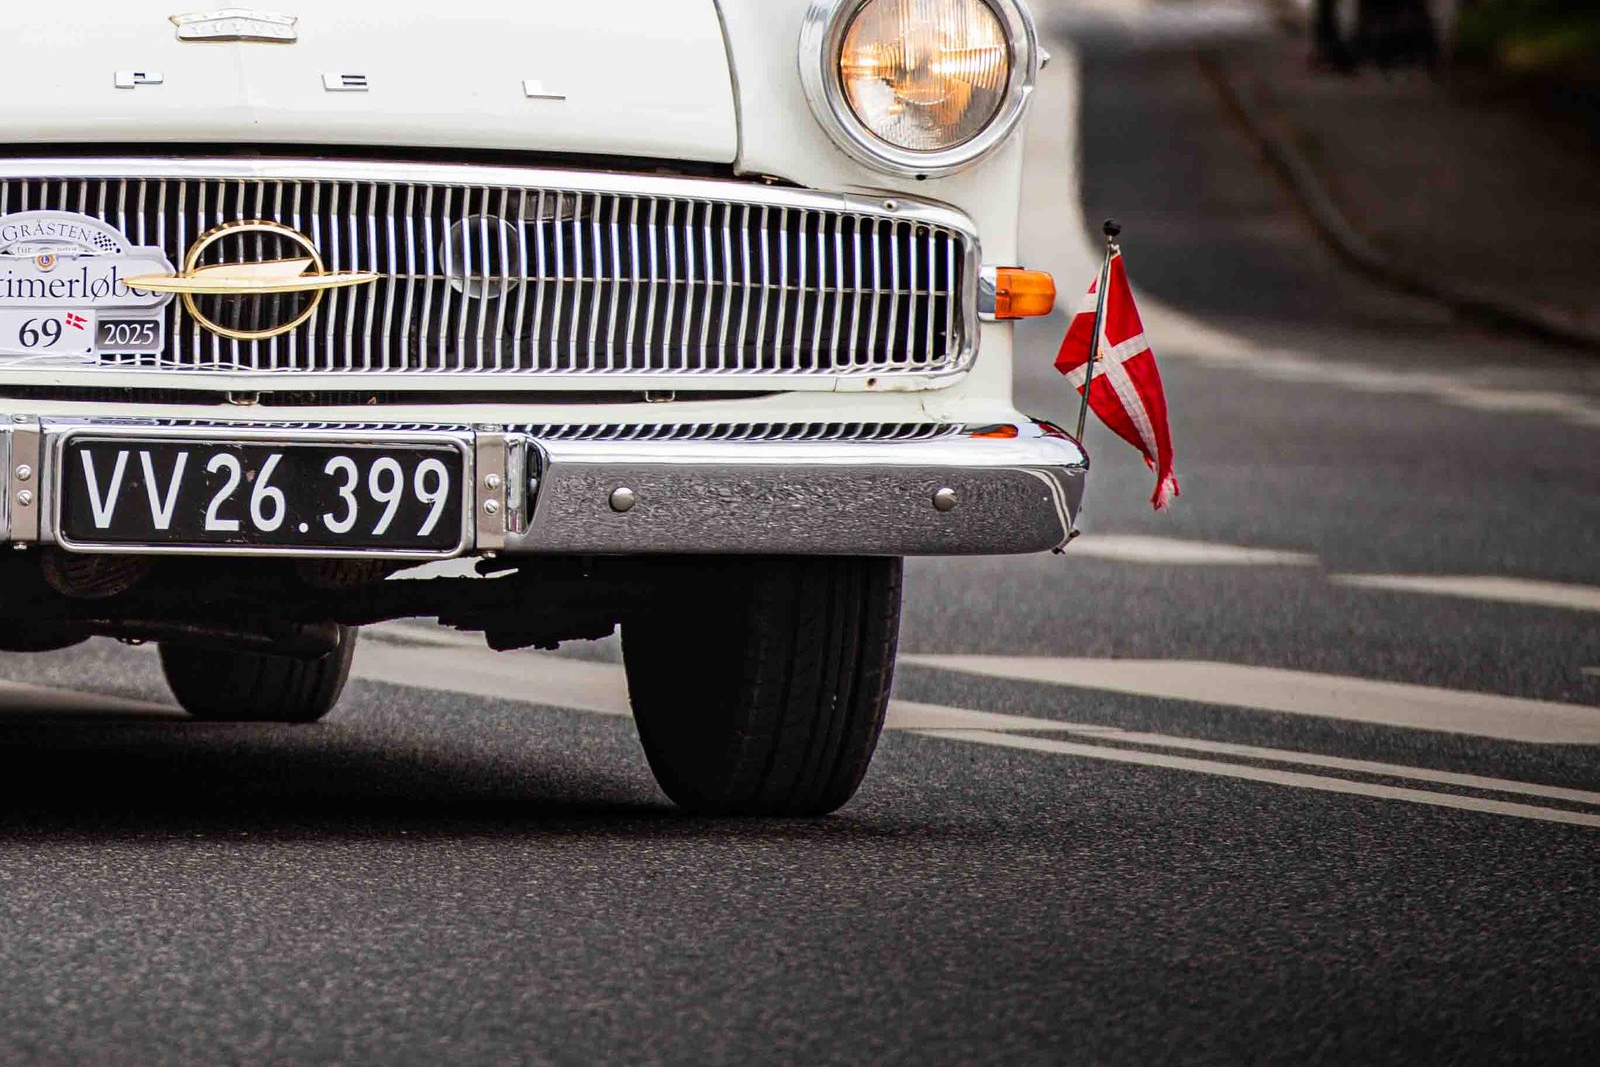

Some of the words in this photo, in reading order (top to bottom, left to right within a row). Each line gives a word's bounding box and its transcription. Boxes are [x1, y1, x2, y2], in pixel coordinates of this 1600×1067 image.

[2, 219, 92, 242] GRÅSTEN
[19, 318, 62, 348] 69
[103, 323, 154, 345] 2025
